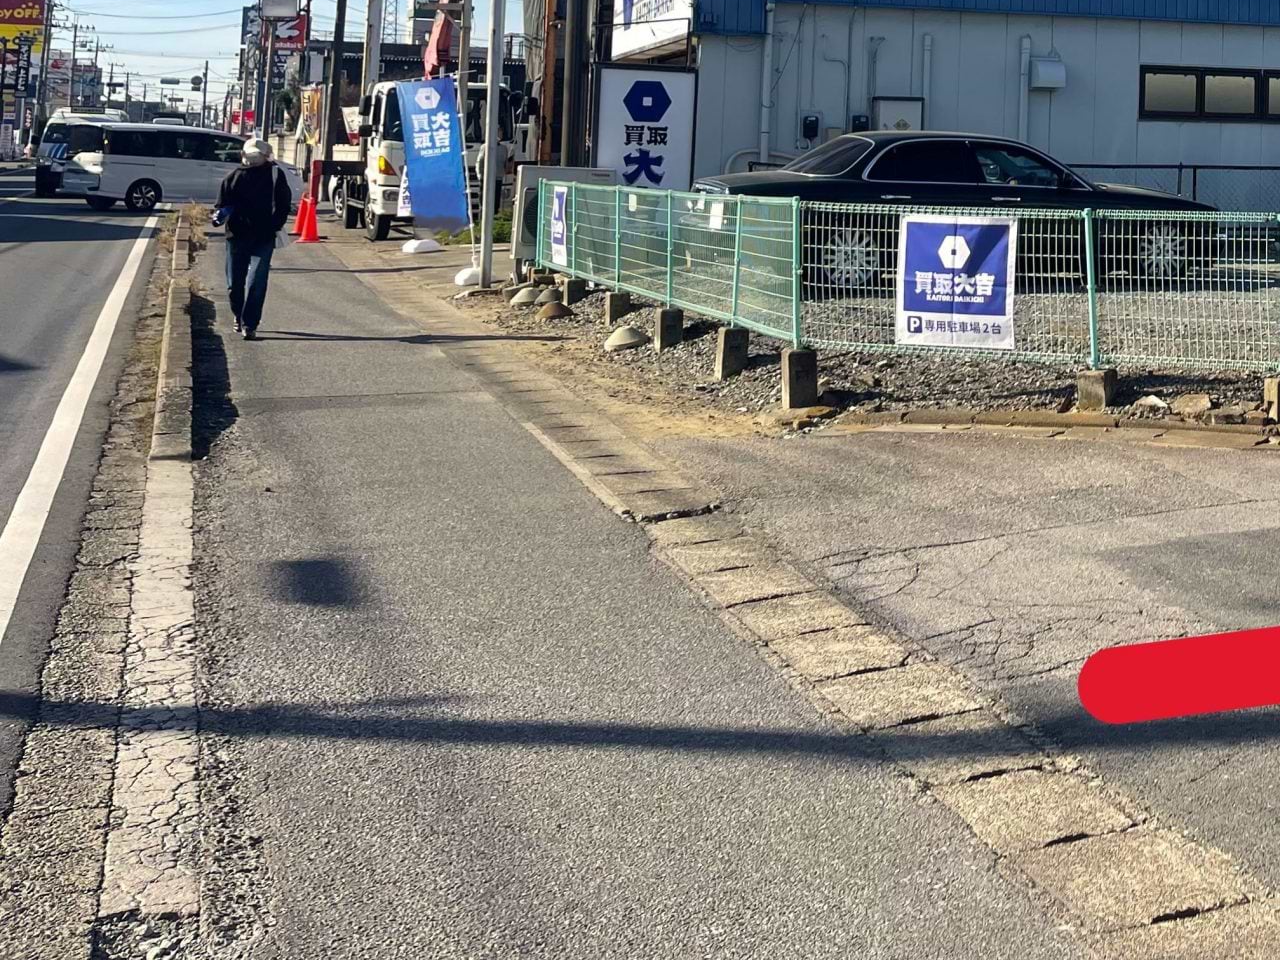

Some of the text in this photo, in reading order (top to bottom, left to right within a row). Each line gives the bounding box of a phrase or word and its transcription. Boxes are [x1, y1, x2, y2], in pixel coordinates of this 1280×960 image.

[14, 8, 40, 18] OFF
[624, 124, 668, 146] 買取
[915, 271, 995, 296] 買取大吉
[926, 294, 984, 303] KAITORI DAIKICHI
[925, 319, 1002, 334] 専用駐車場2台
